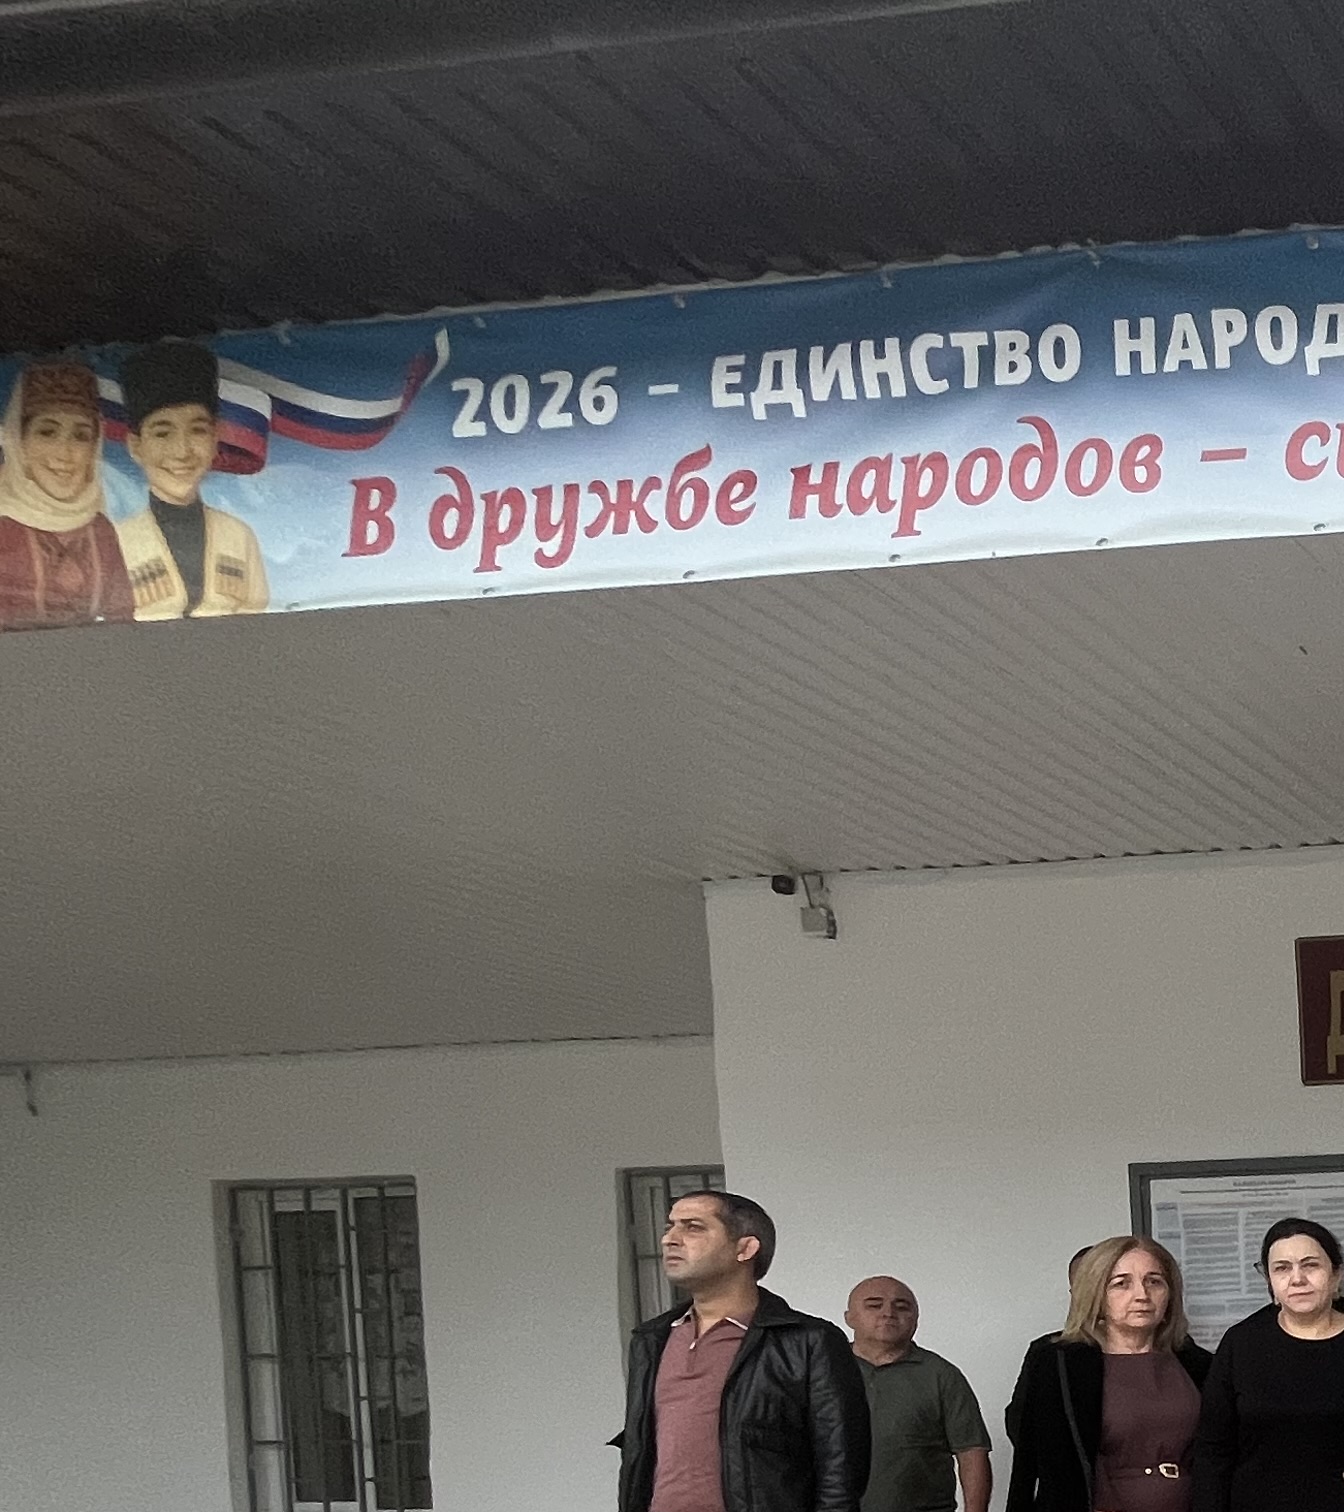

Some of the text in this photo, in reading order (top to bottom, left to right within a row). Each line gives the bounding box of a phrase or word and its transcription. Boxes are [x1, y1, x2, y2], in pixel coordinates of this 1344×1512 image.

[453, 366, 618, 438] 2026
[711, 323, 1082, 420] ЕДИНСТВО
[342, 476, 396, 558] В
[428, 443, 757, 573] дружбе
[789, 416, 1163, 538] народов
